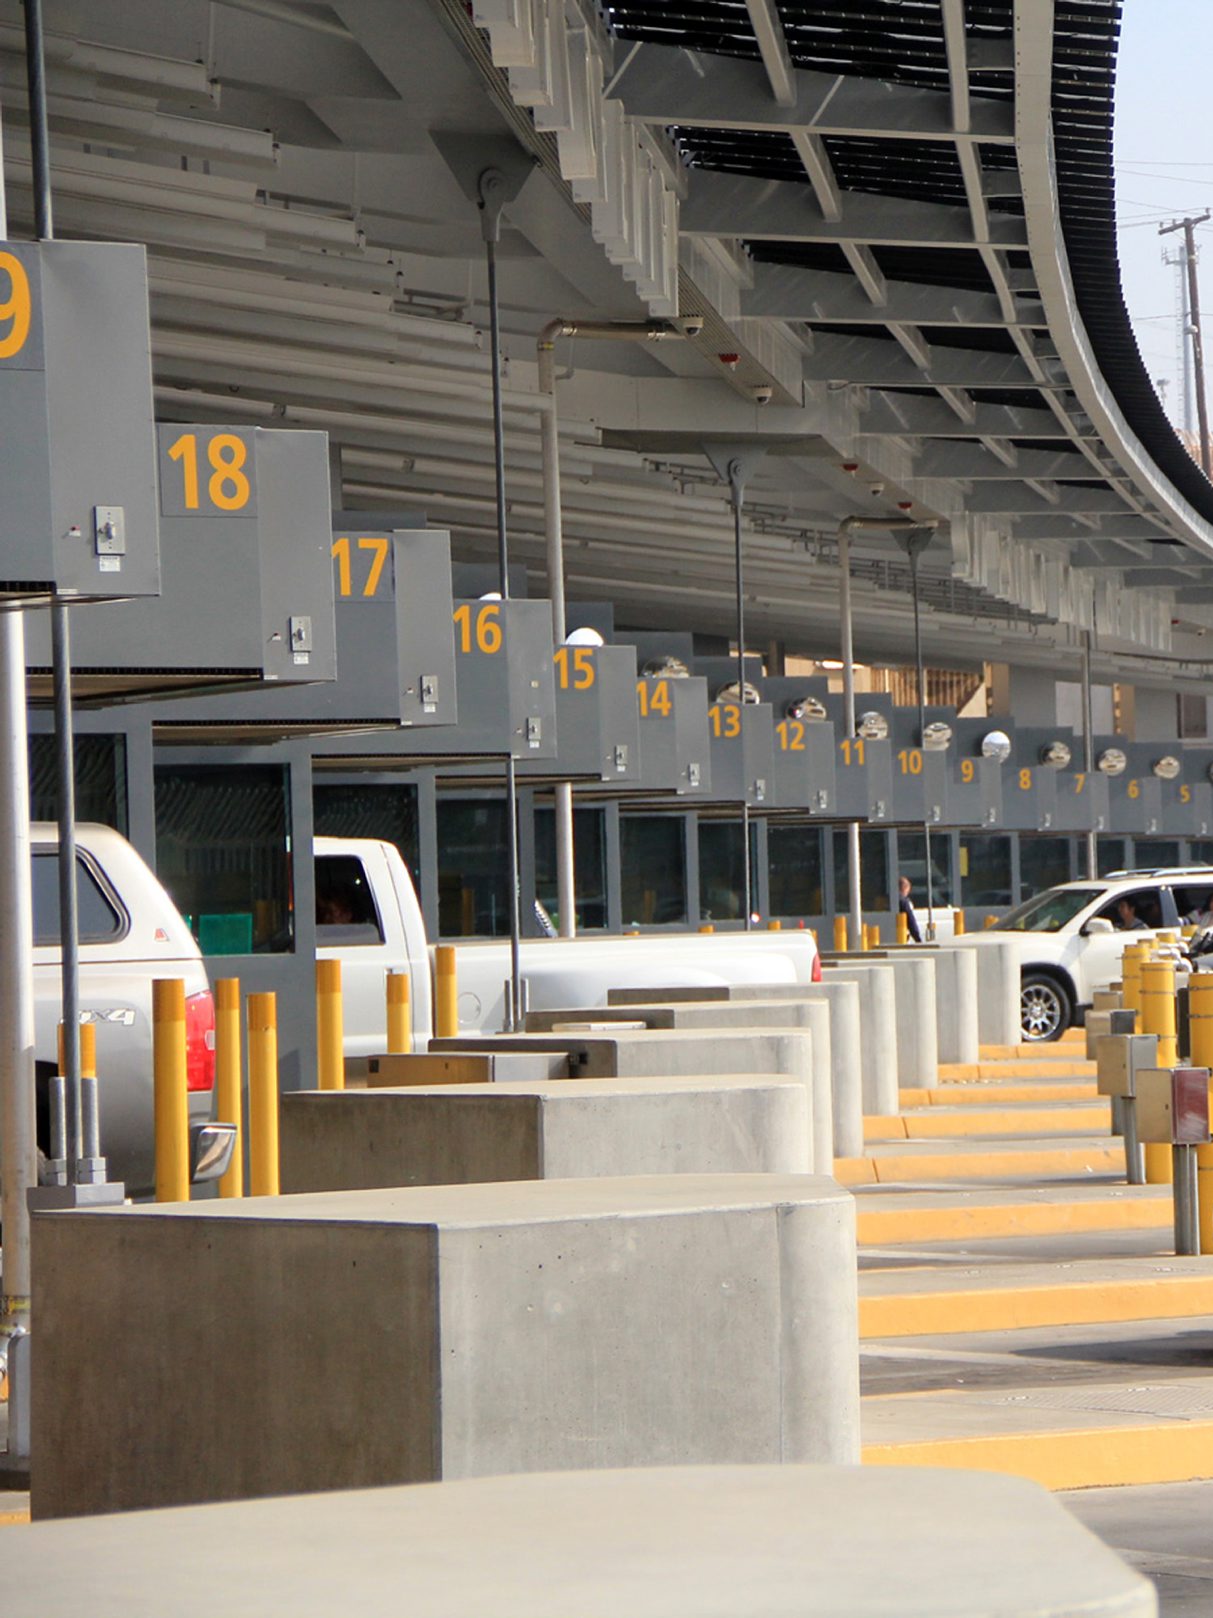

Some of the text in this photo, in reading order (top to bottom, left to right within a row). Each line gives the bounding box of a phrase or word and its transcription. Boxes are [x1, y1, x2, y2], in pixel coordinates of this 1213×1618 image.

[168, 434, 250, 510] 18
[332, 537, 388, 596] 17
[453, 605, 502, 653] 16
[553, 648, 595, 689] 15
[637, 681, 671, 716] 14
[708, 705, 741, 737] 13
[776, 721, 805, 750] 12
[841, 740, 865, 765] 11
[898, 750, 922, 774] 10
[961, 760, 974, 783] 9
[1019, 768, 1031, 789] 8
[1074, 773, 1085, 793] 7
[1128, 780, 1140, 799] 6
[1179, 784, 1190, 803] 5
